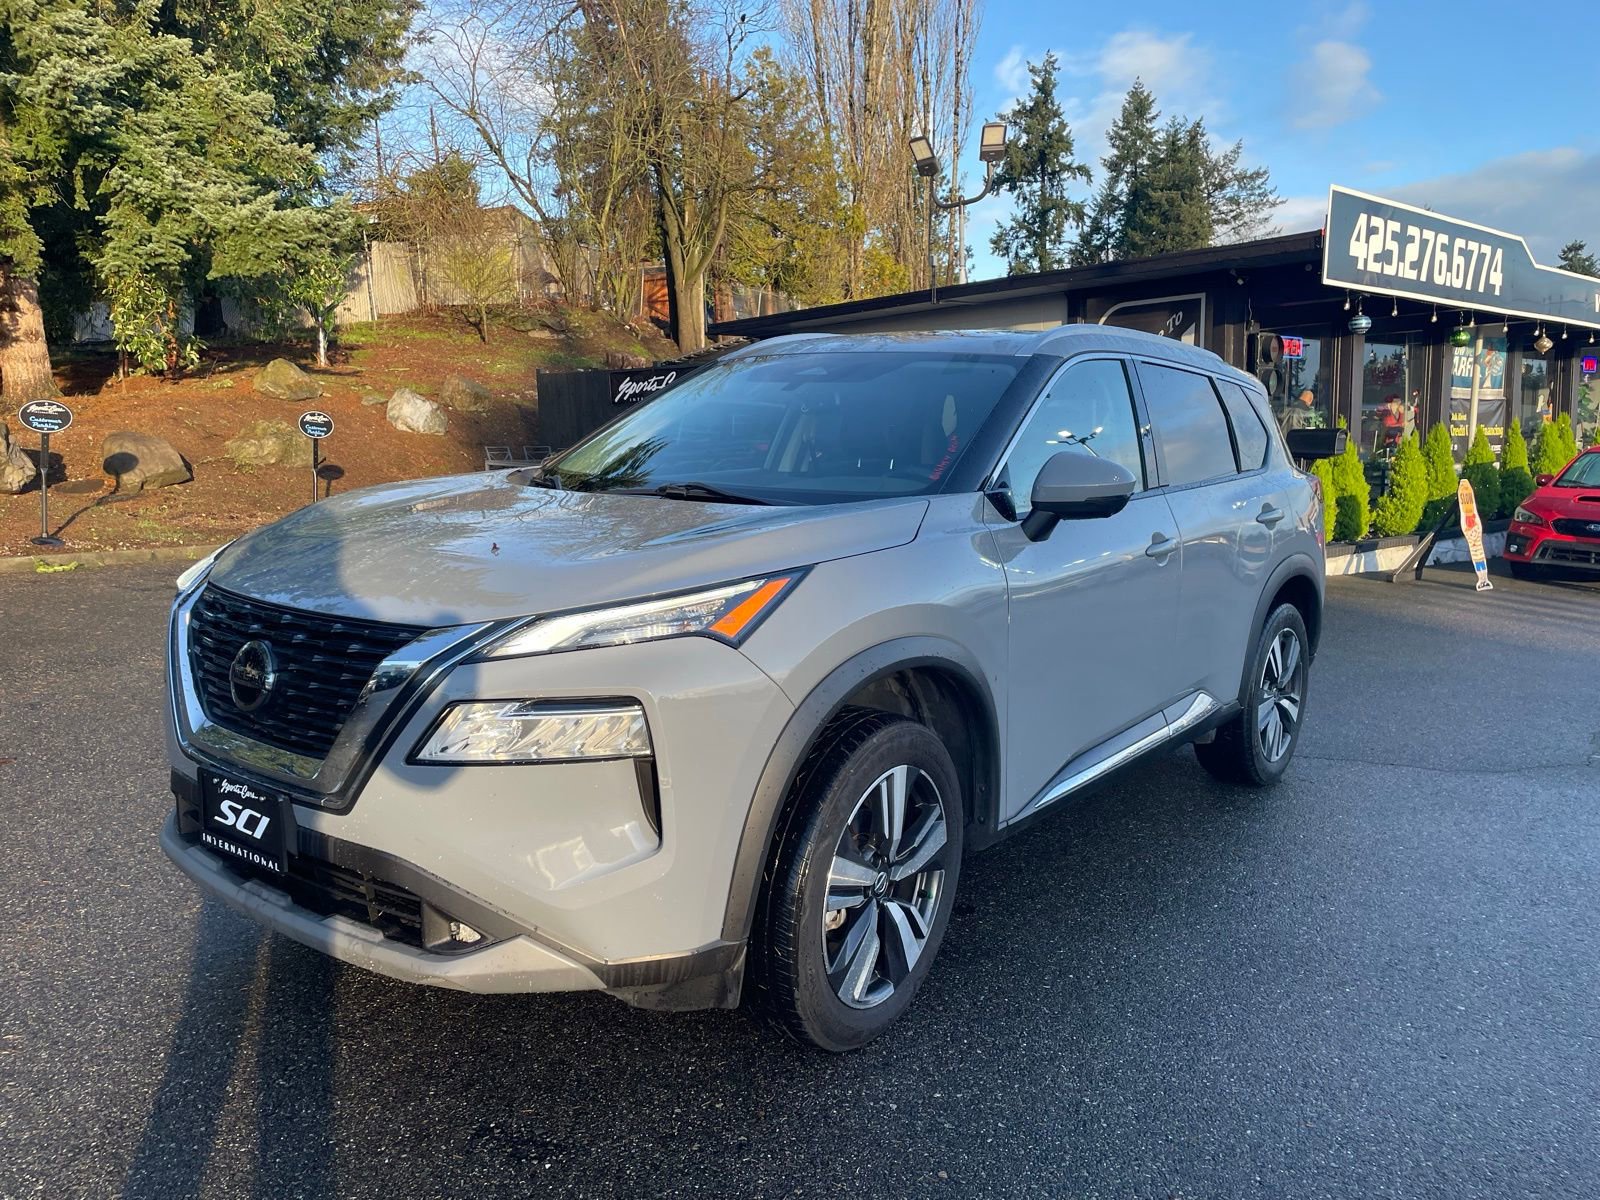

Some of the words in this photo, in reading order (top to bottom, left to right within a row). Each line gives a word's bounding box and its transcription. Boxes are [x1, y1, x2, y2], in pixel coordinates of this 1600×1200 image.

[1349, 213, 1503, 296] 425.276.6774
[1167, 311, 1183, 334] TO
[220, 779, 243, 794] Sports
[241, 785, 259, 799] Cars
[213, 799, 270, 840] SCI
[202, 832, 280, 872] INTERNATIONAL
